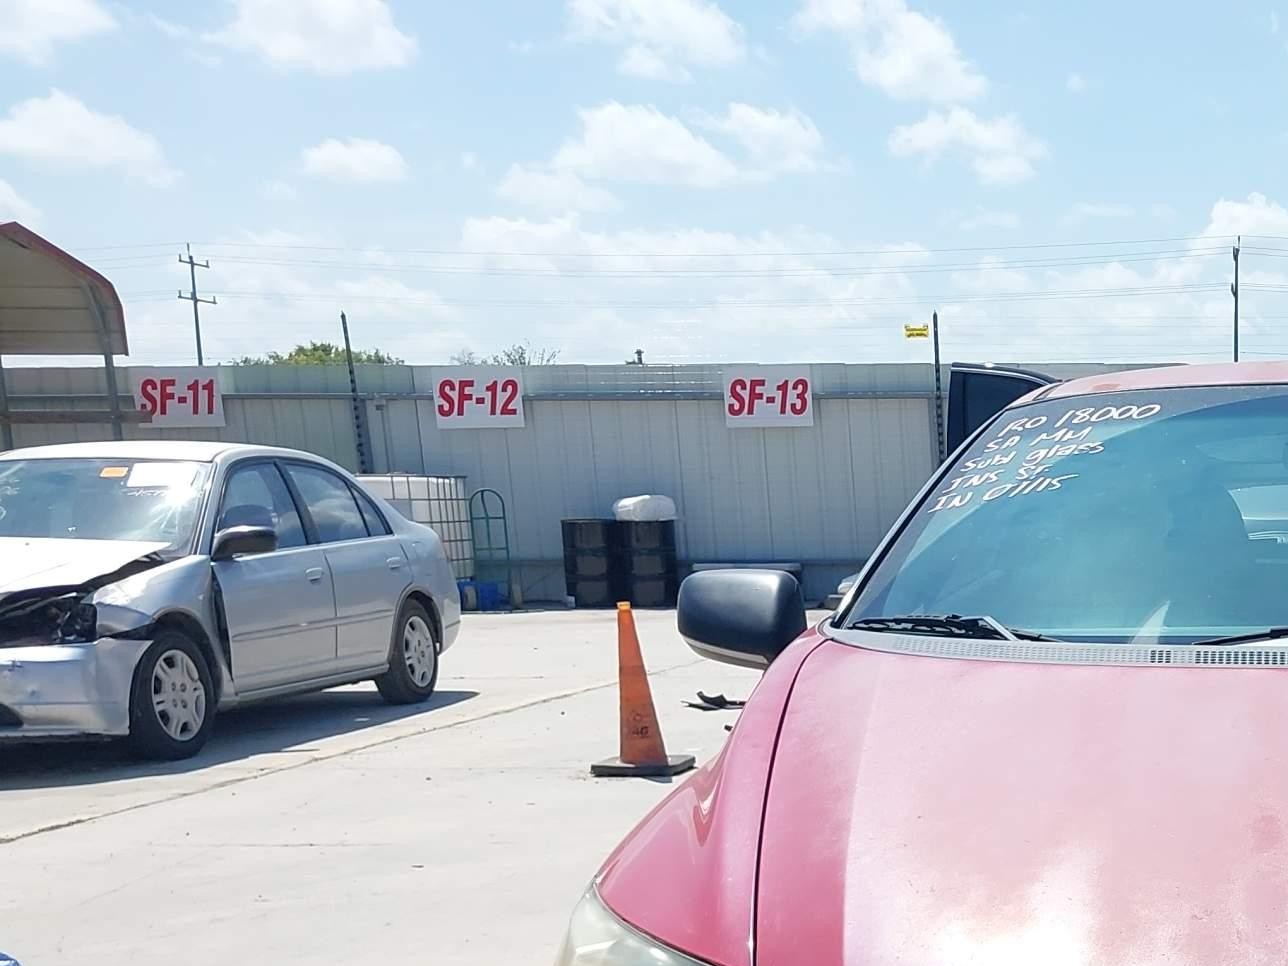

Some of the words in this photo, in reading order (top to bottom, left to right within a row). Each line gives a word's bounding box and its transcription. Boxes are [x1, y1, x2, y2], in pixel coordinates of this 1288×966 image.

[140, 378, 215, 416] SF-11
[438, 379, 518, 418] SF-12
[728, 378, 809, 417] SF-13
[1054, 404, 1161, 428] 18000
